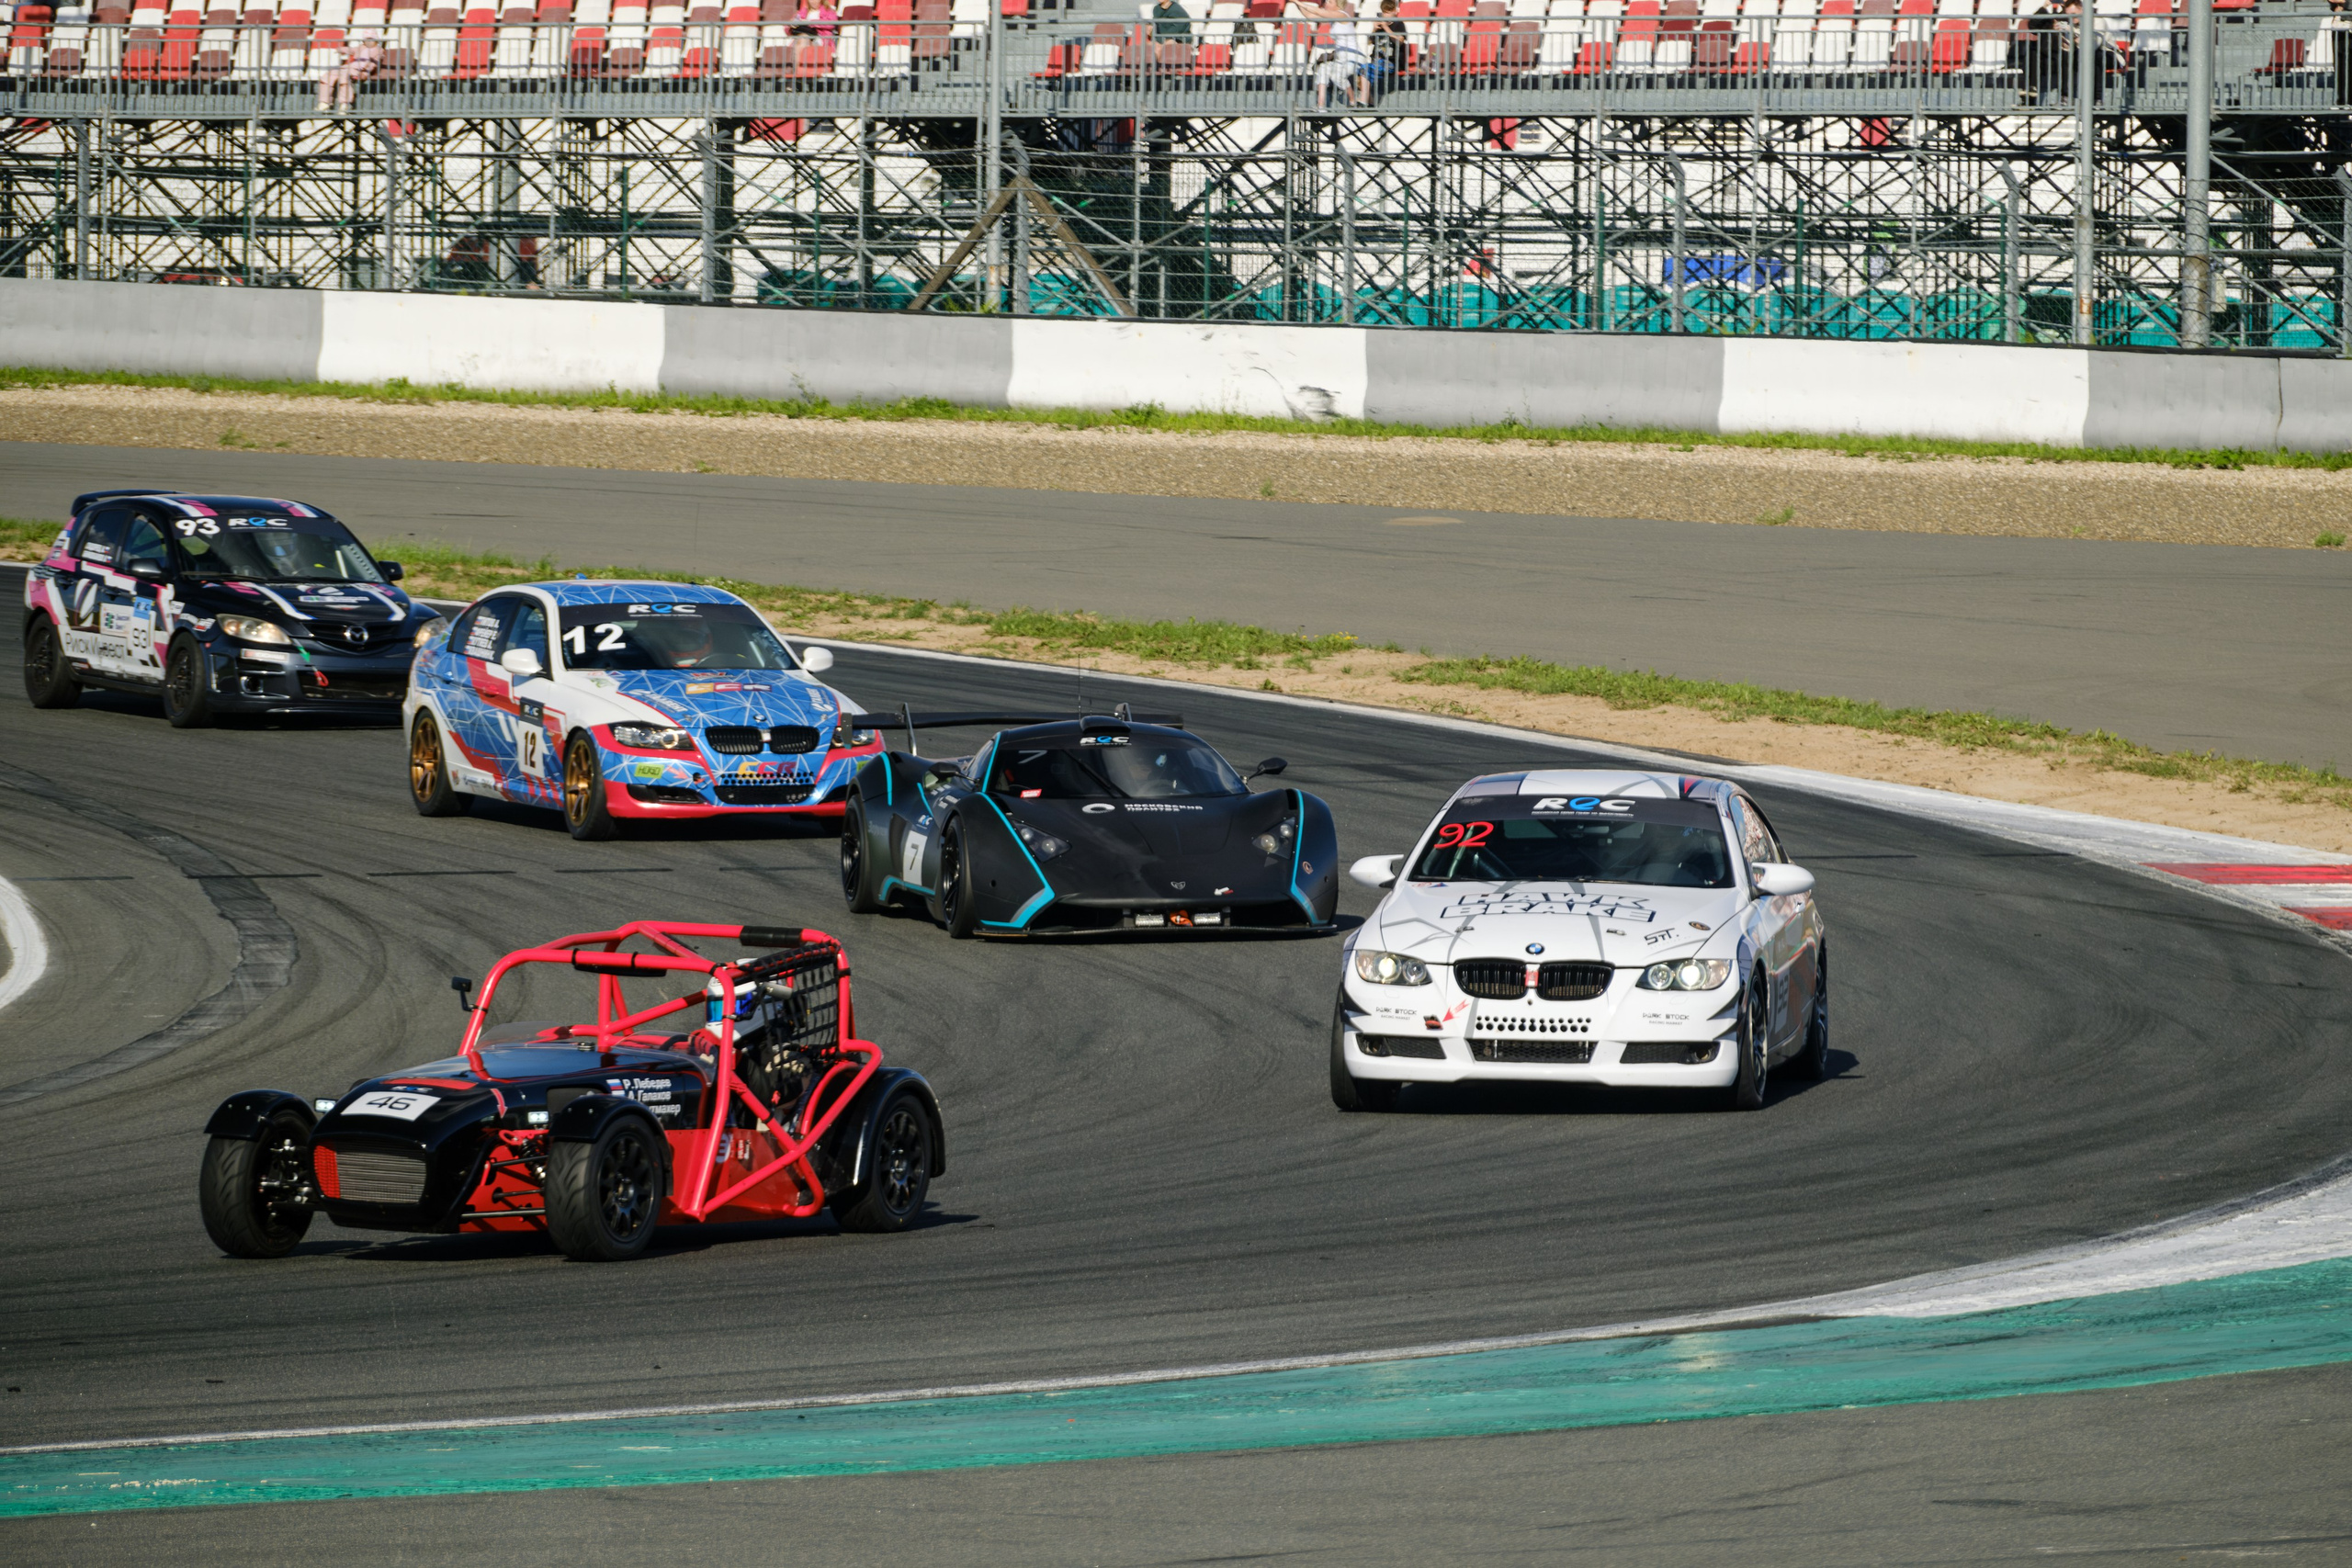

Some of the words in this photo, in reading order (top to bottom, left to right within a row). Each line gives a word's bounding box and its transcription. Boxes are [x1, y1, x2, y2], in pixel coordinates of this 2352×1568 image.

[175, 517, 220, 536] 93
[132, 627, 148, 649] 93
[562, 623, 627, 655] 12
[524, 730, 537, 769] 12
[1017, 750, 1048, 764] 7
[1434, 821, 1494, 849] 92
[910, 842, 920, 871] 7
[1457, 892, 1651, 909] HAWK
[1440, 901, 1657, 922] BRAKE
[366, 1095, 418, 1111] 46
